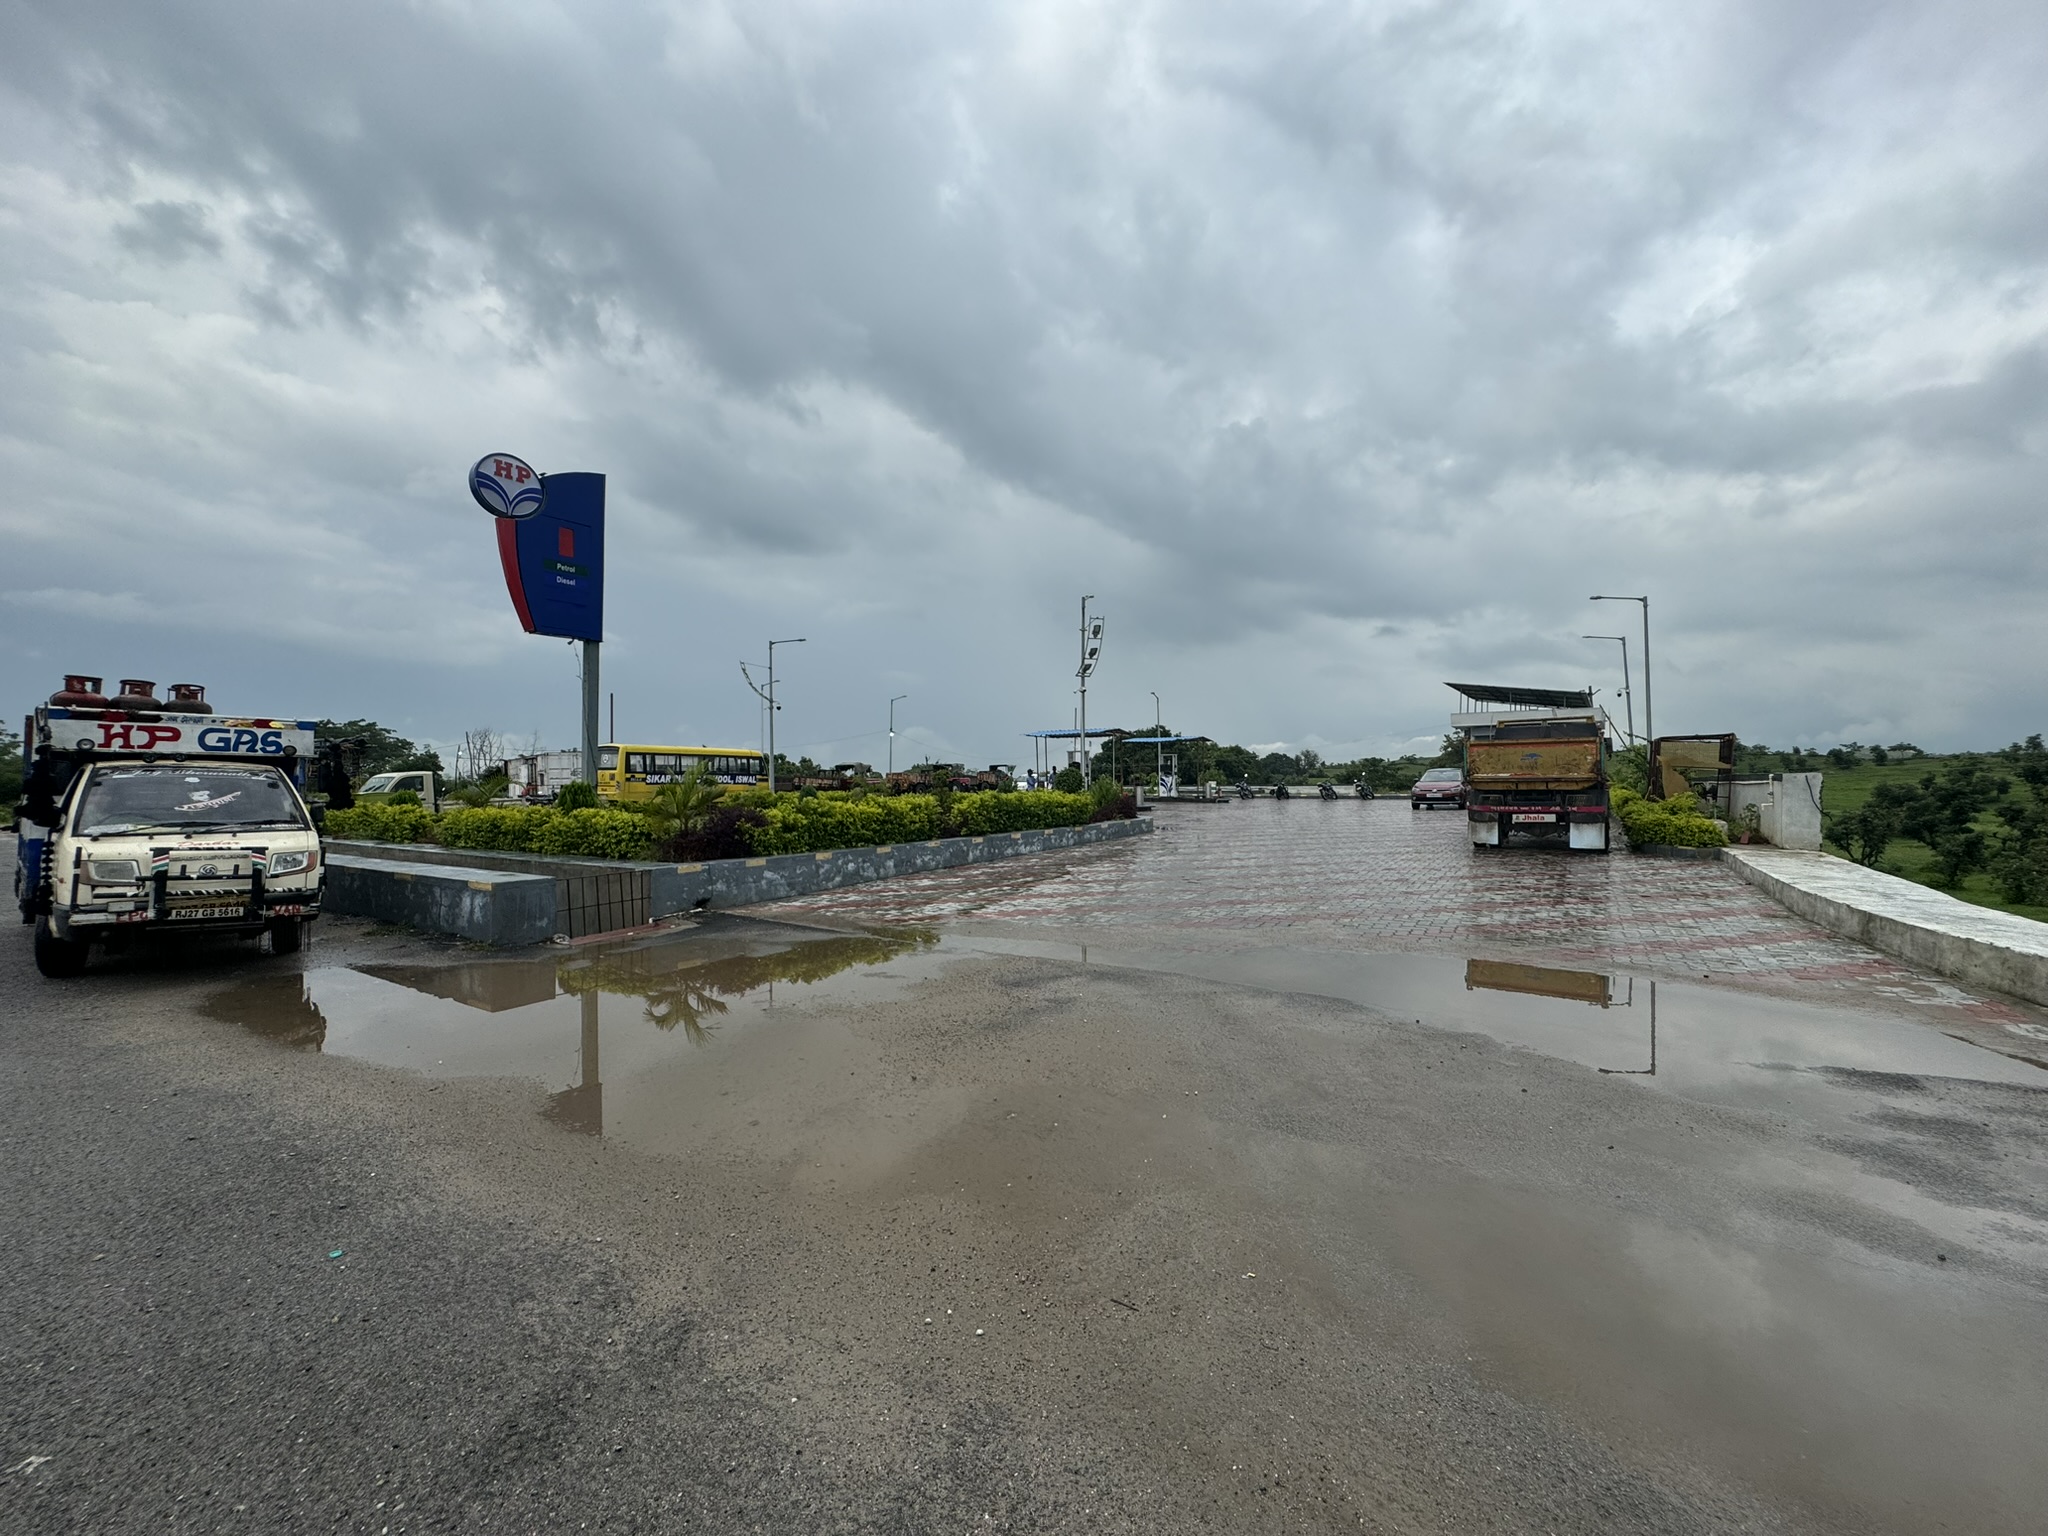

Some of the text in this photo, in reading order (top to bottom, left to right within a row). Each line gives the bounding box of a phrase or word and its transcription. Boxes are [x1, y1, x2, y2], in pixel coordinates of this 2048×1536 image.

[493, 458, 532, 484] HP
[556, 563, 576, 573] Petrol
[556, 575, 576, 586] Diesel
[97, 723, 284, 754] HP GAS
[645, 774, 672, 783] SIKAR
[735, 775, 757, 784] ISWAL
[1521, 814, 1546, 822] Jhala
[175, 907, 241, 919] RJ27 GB 5616
